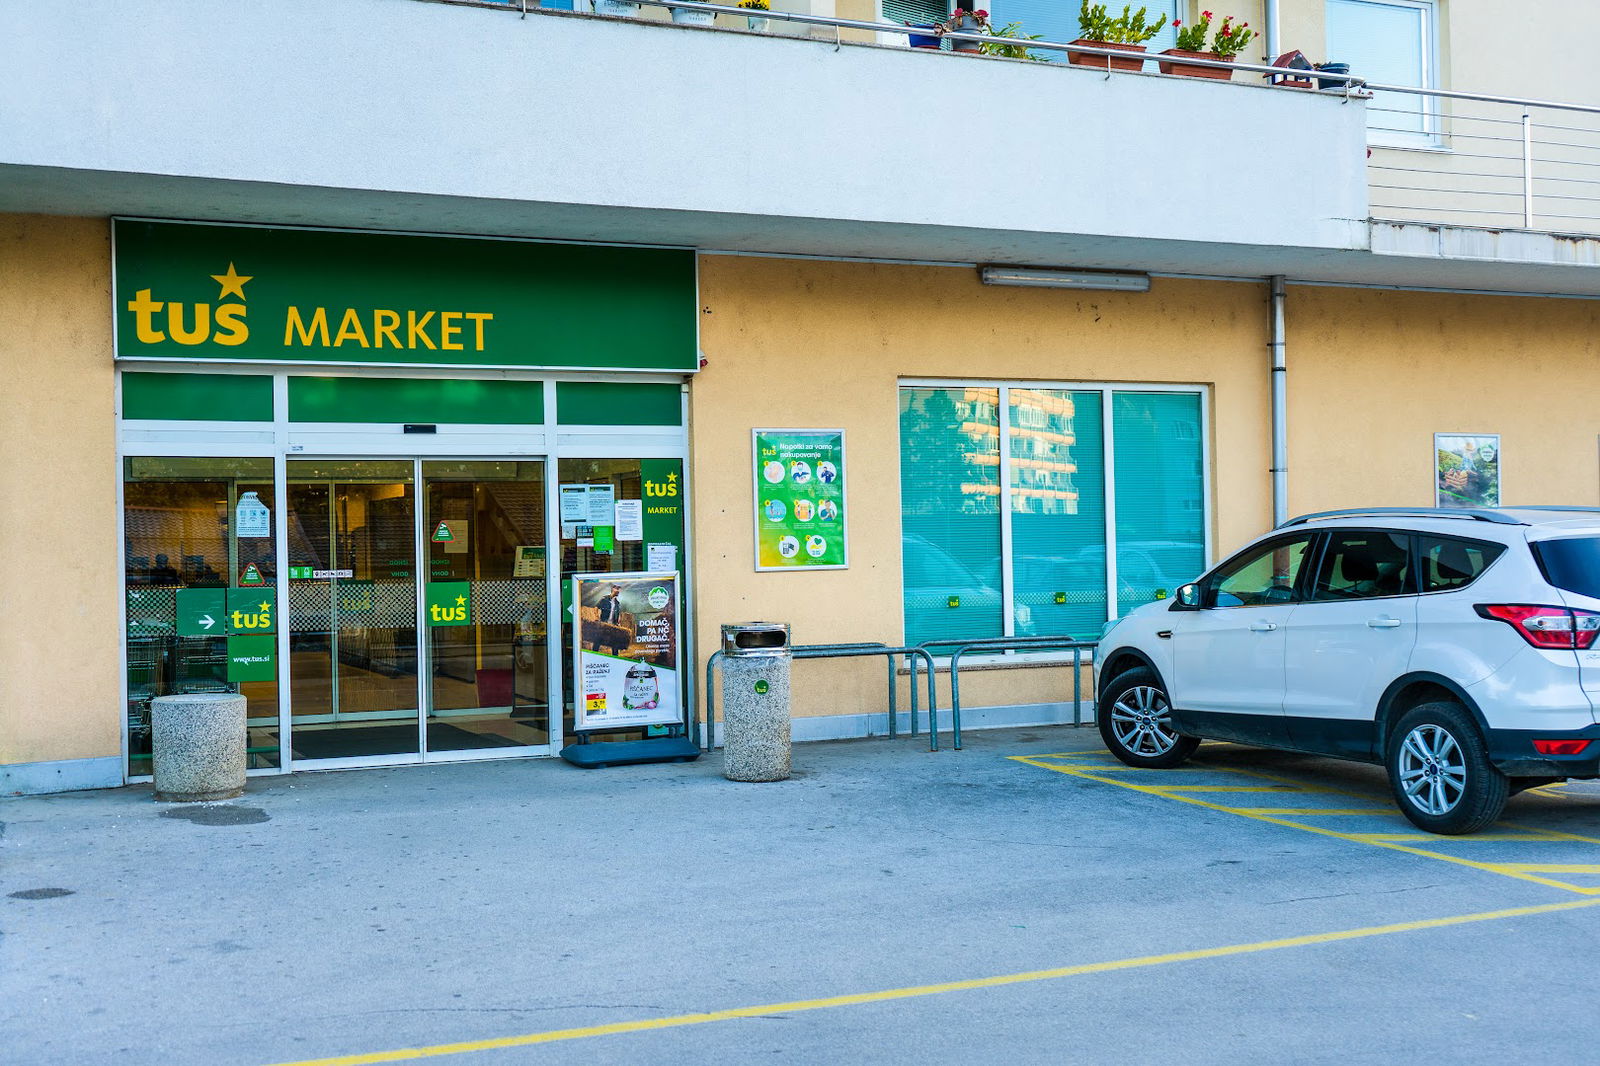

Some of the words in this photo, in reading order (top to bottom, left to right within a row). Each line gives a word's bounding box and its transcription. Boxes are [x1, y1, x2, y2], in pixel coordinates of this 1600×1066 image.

[284, 306, 494, 351] MARKET
[647, 506, 677, 514] MARKET
[636, 634, 670, 642] DRUGAČ.
